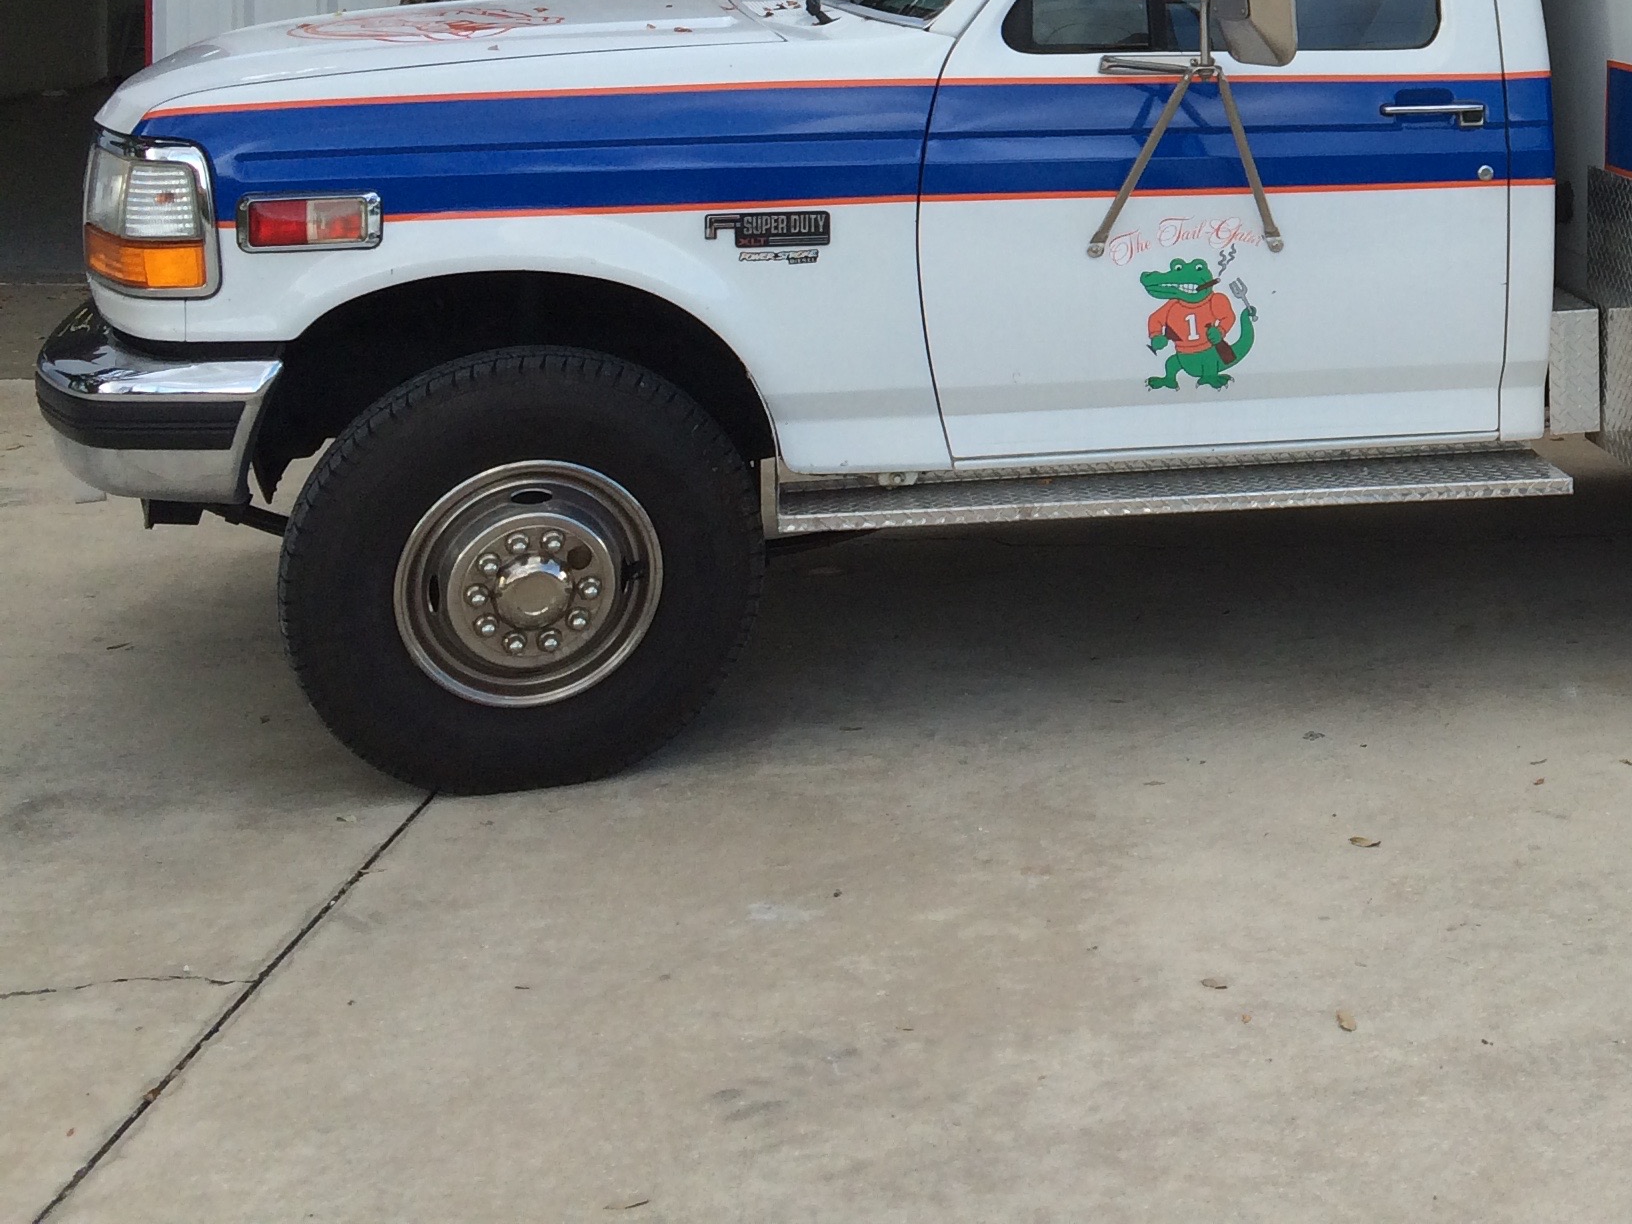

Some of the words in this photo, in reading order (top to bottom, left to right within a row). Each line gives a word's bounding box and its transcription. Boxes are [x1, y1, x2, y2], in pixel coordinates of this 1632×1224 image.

[743, 215, 787, 235] SUPER
[790, 214, 826, 233] DUTY
[738, 237, 767, 246] XLT
[1109, 229, 1151, 266] The
[1184, 314, 1200, 340] 1
